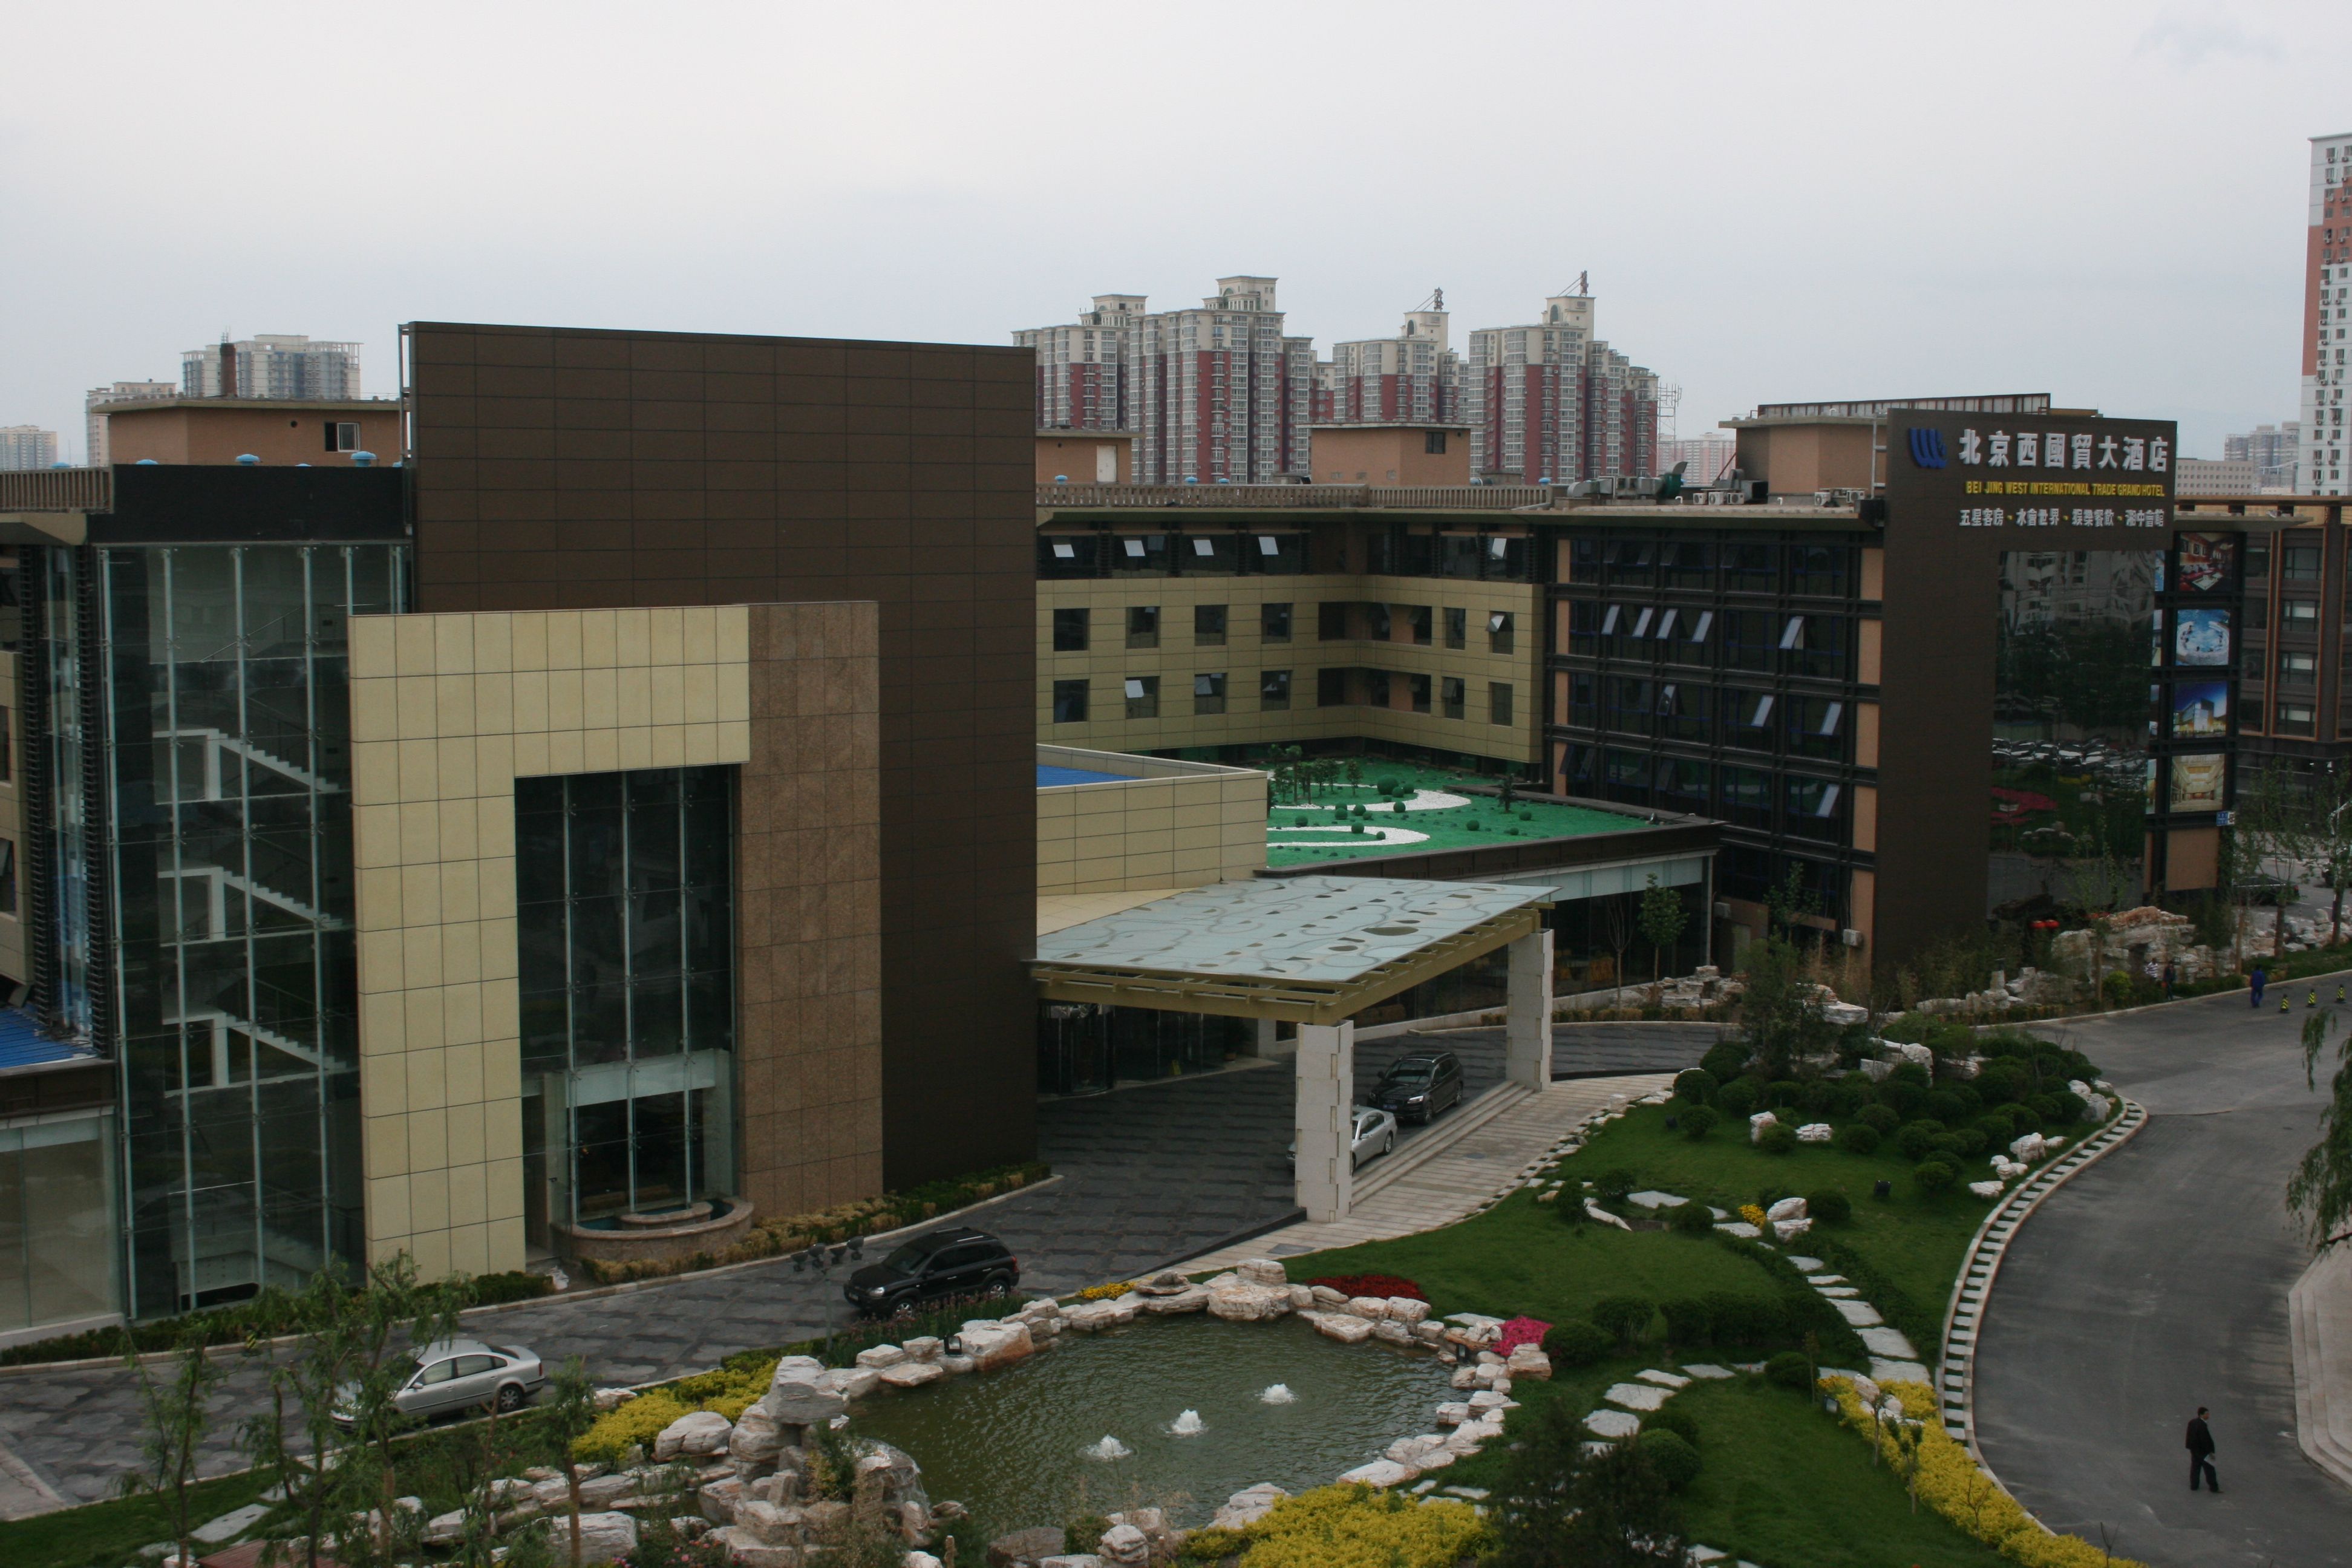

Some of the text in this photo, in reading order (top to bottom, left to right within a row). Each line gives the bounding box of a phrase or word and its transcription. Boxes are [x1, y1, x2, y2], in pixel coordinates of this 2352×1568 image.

[1958, 428, 2168, 472] 北京西國貿大酒店
[1966, 481, 2165, 497] BEI JING WEST INTERNATIONAL TRADE GRAND HOTEL
[1959, 508, 2004, 527] 五星客房
